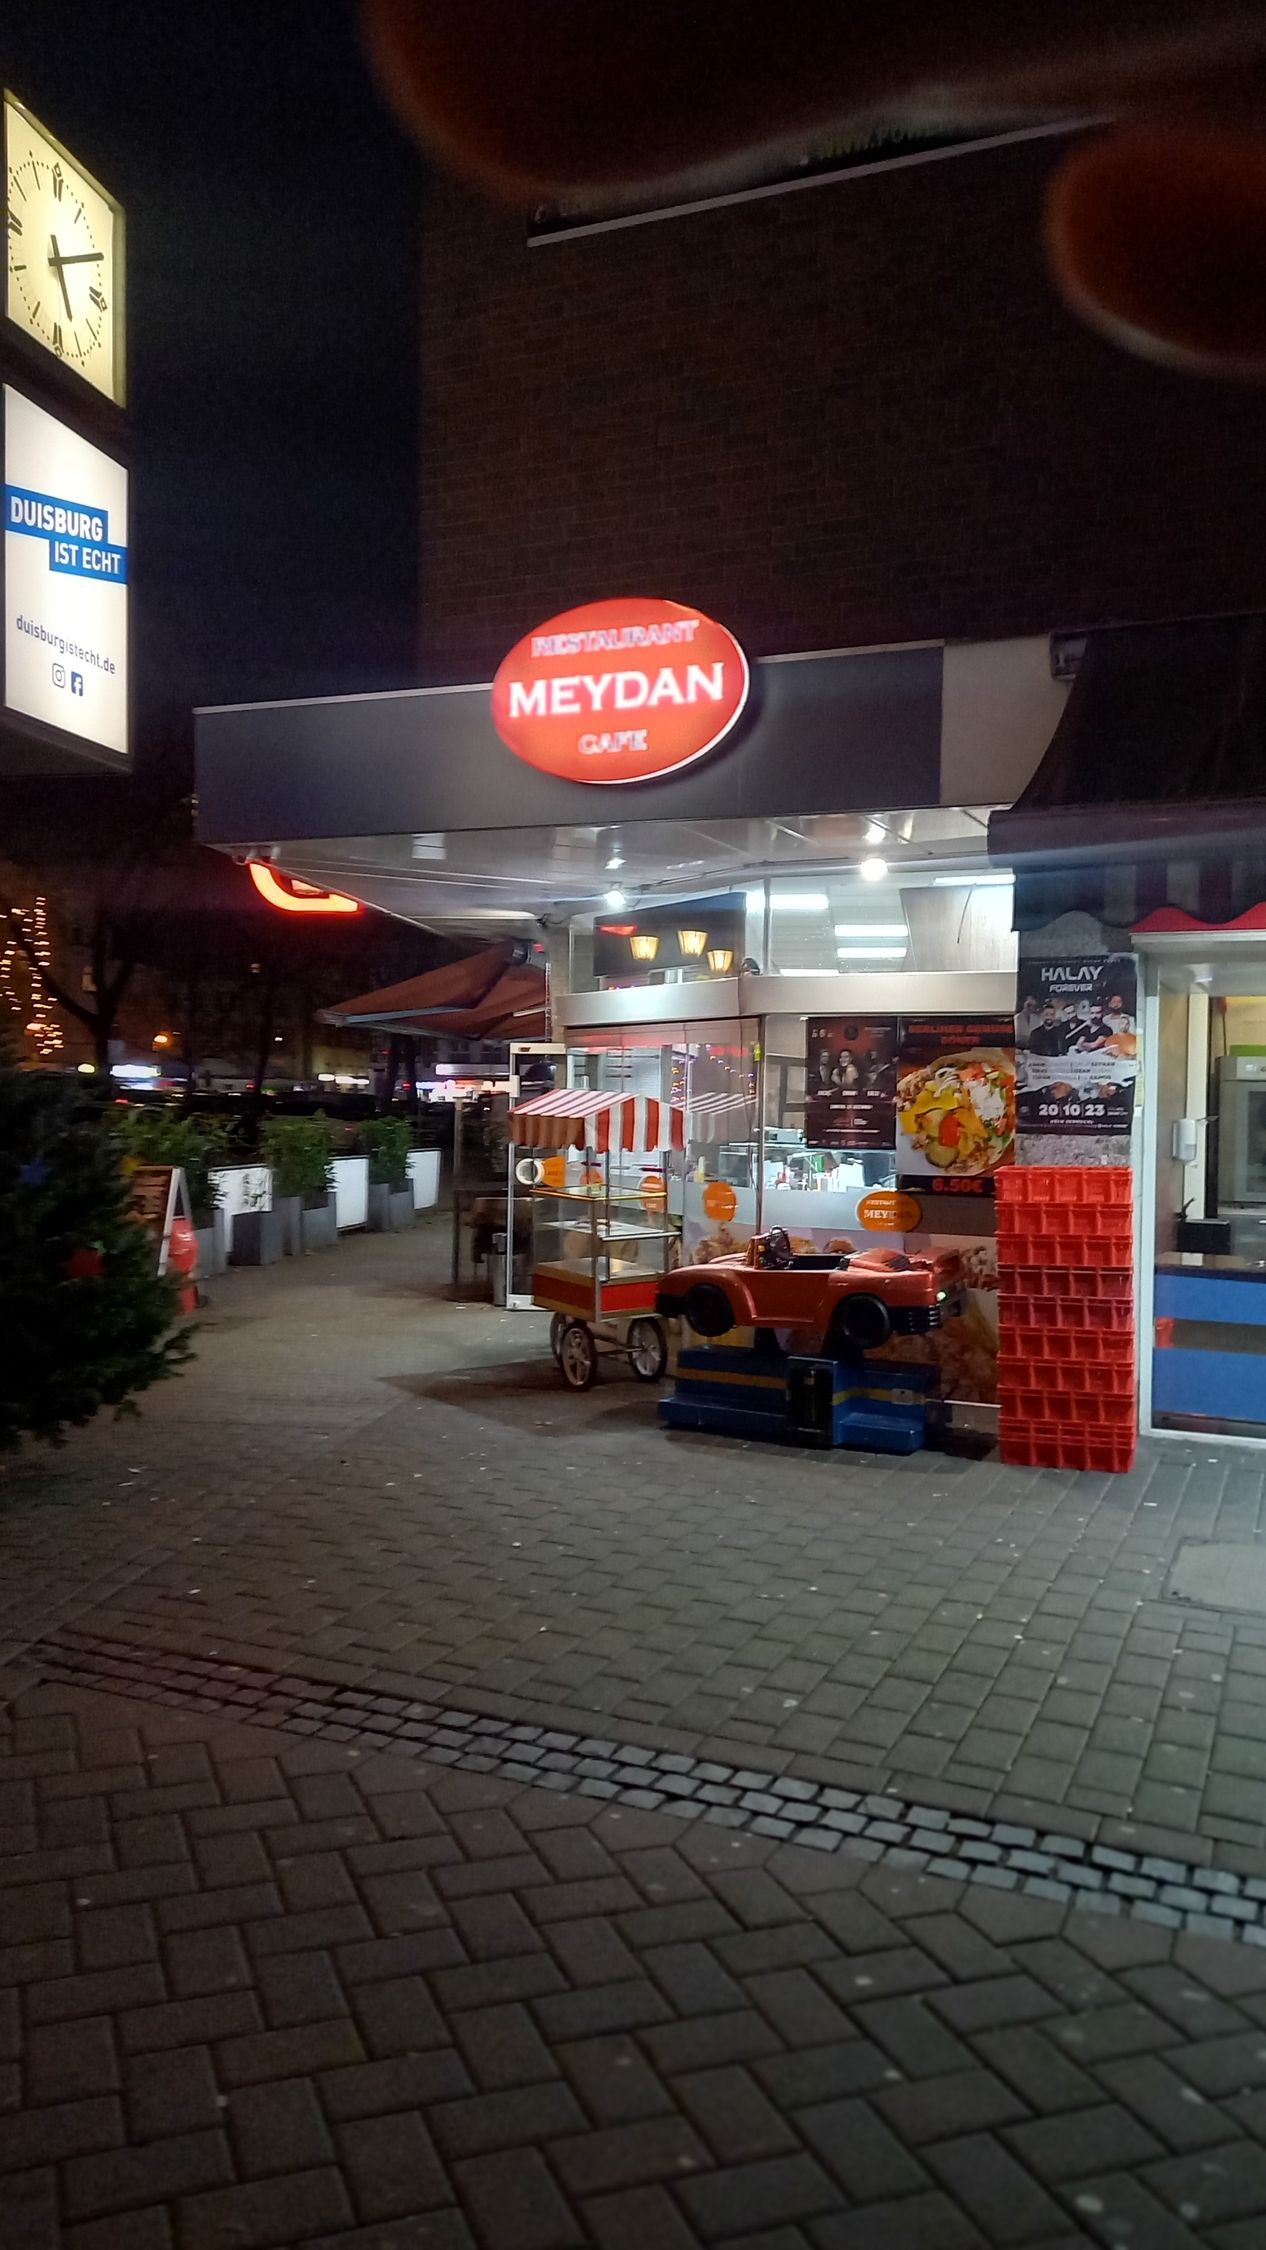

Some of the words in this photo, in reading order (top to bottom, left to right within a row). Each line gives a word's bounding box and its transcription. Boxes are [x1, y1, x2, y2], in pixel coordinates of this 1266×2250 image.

[10, 495, 104, 542] DUISBURG
[54, 540, 79, 567] IST
[82, 546, 122, 574] ECHT
[16, 614, 116, 675] duisburgistecht.de
[531, 619, 700, 658] RESTAURANT
[508, 662, 725, 718] MEYDAN
[577, 729, 649, 755] CAFE
[1041, 965, 1104, 981] HALAY
[1049, 983, 1093, 993] FOREVER
